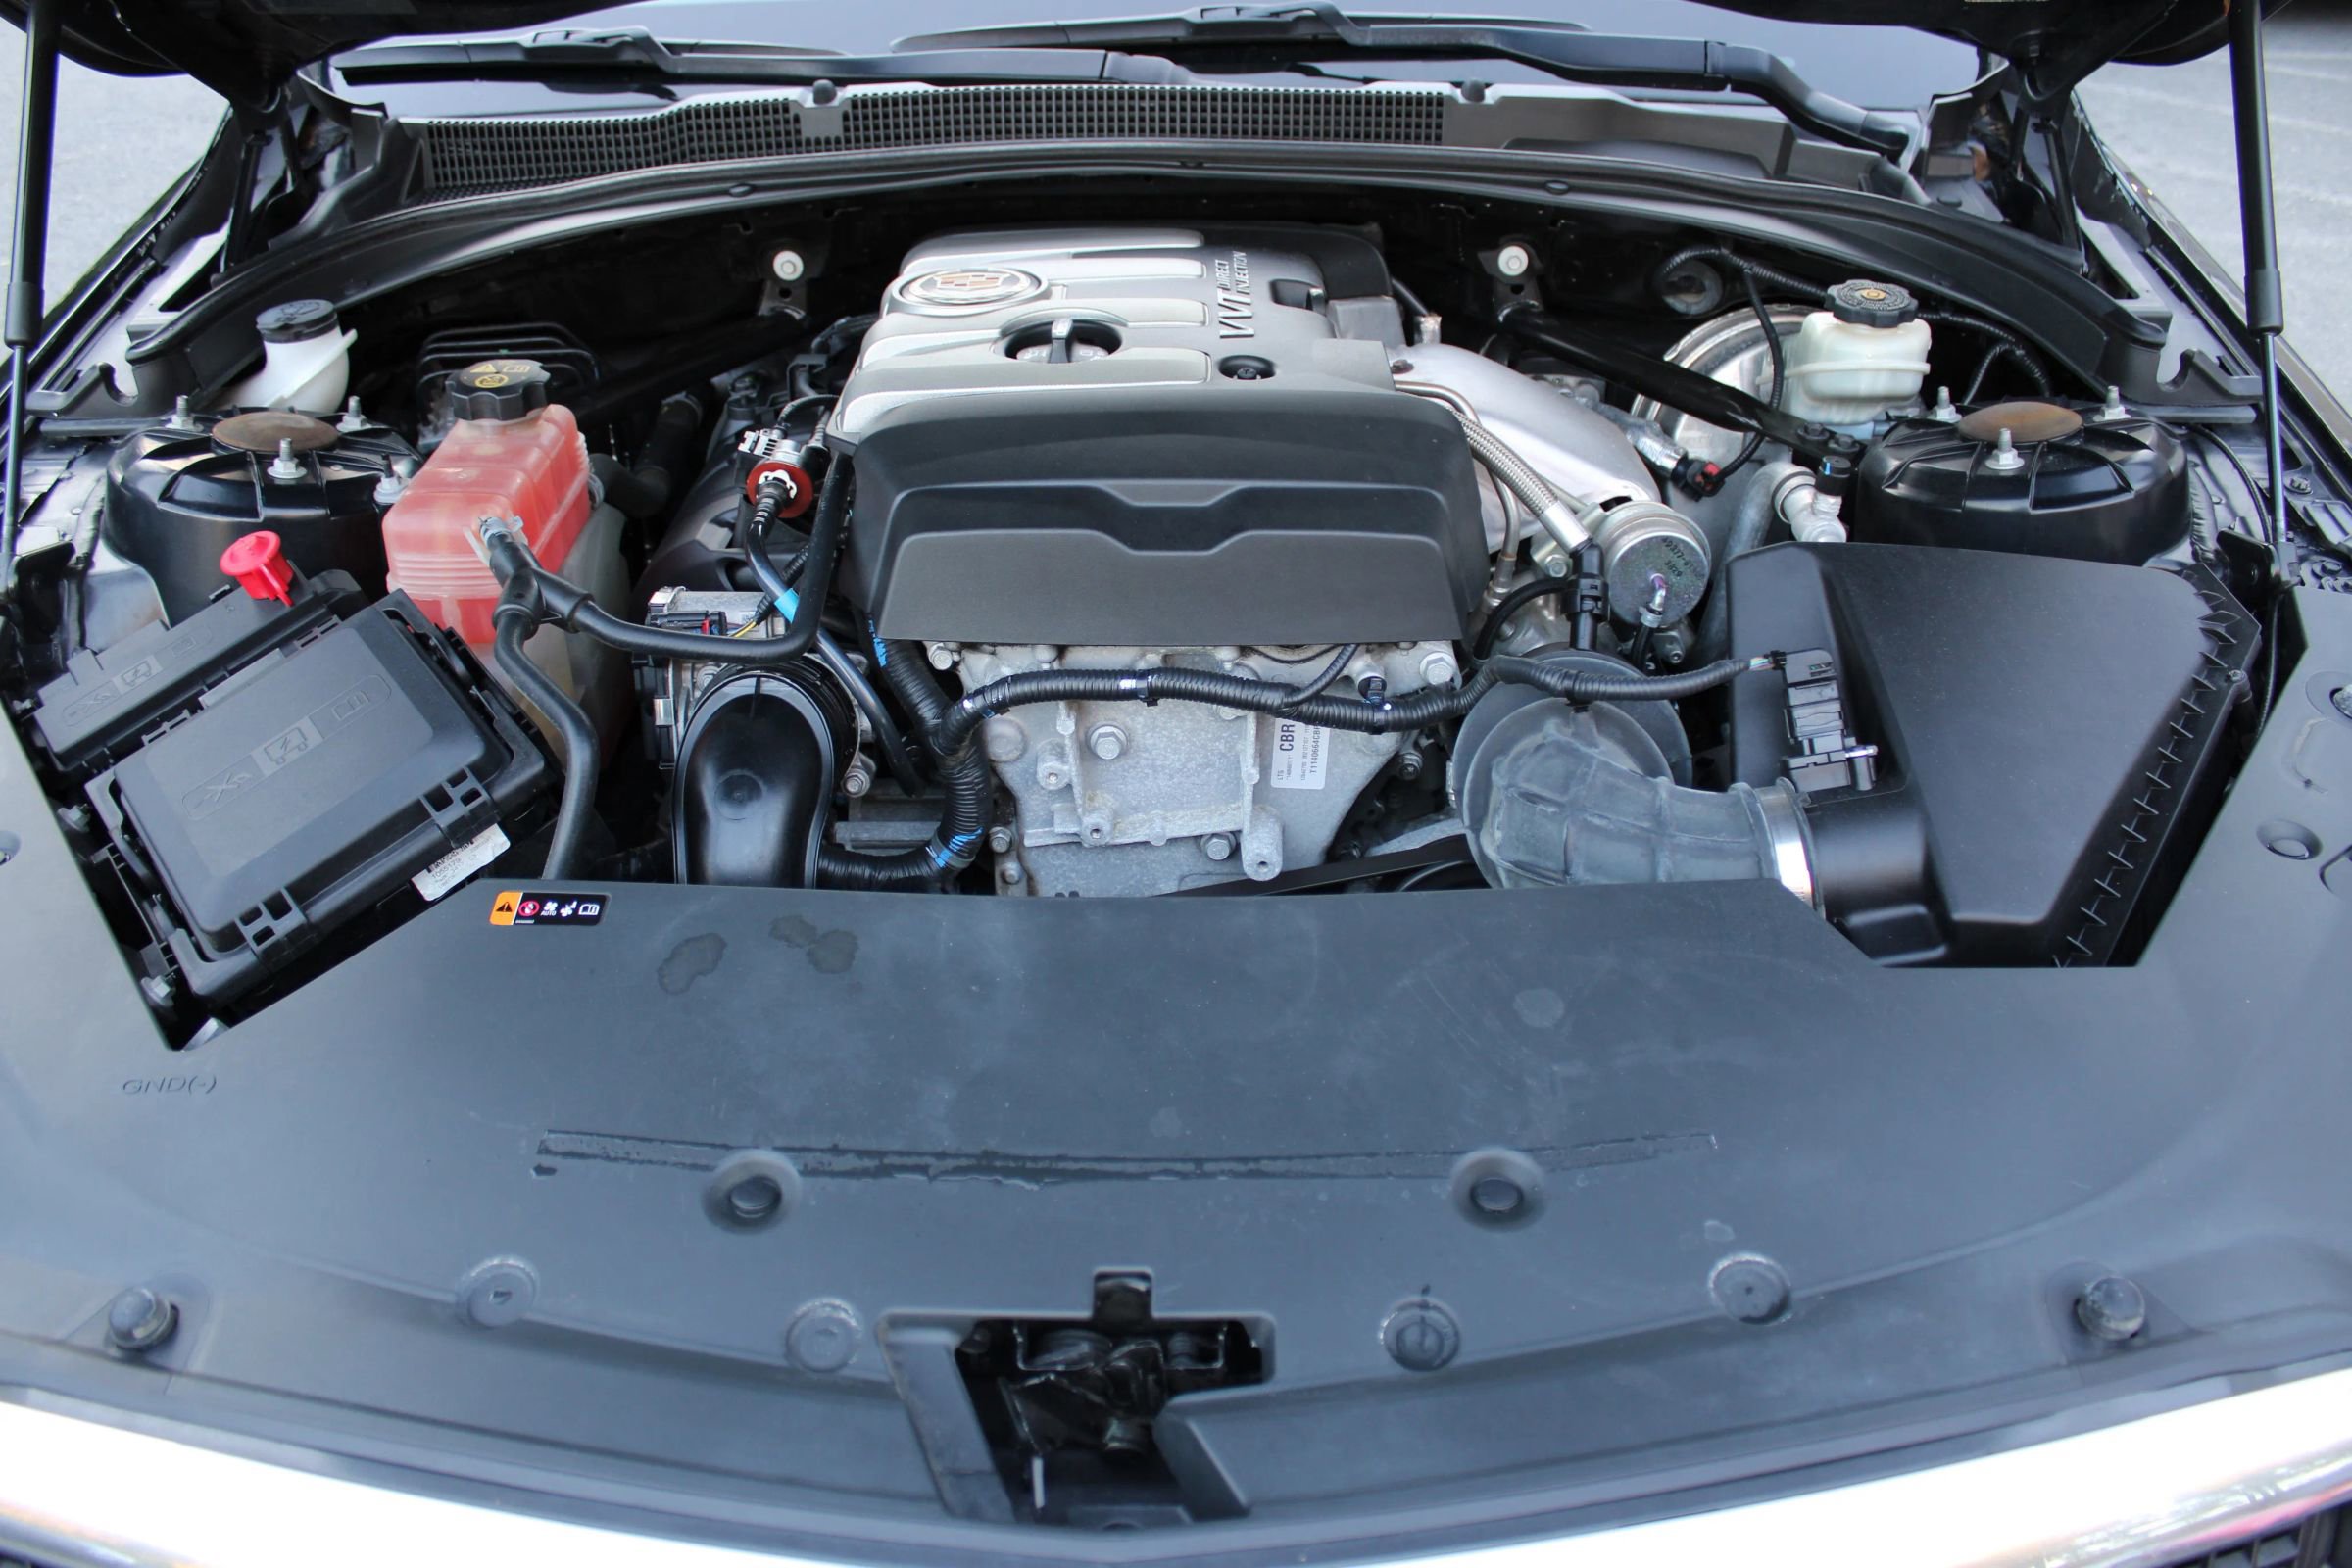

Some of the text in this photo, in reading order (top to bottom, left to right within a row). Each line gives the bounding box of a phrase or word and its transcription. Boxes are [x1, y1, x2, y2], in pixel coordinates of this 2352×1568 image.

[1215, 259, 1231, 291] DIRECT
[1233, 251, 1250, 295] INJECTION
[1217, 287, 1255, 339] VVT
[1280, 724, 1296, 752] CBR
[123, 1075, 217, 1095] GND(-)
